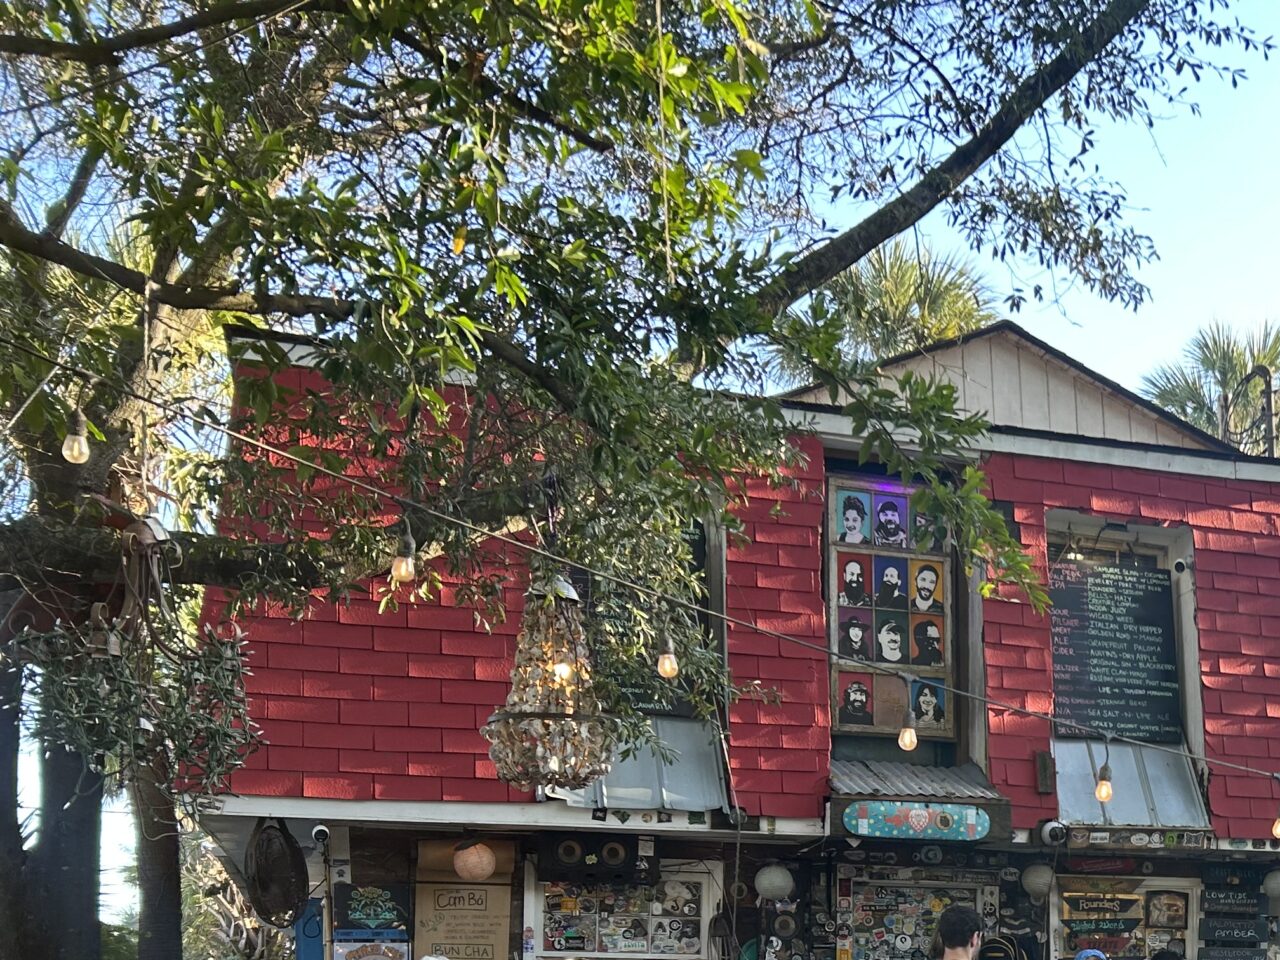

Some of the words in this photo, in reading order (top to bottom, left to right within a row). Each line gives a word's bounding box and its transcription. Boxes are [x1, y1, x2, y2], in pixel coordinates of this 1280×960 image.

[1049, 581, 1066, 590] IPA
[1050, 608, 1069, 616] SOUR
[1089, 620, 1119, 630] ITALIAN
[1123, 623, 1138, 632] DRY
[1054, 636, 1069, 645] ALE
[1133, 643, 1161, 652] PALOMA
[1053, 647, 1075, 656] CIDER
[1136, 653, 1157, 662] APPLE
[1056, 706, 1072, 715] N/A
[1087, 708, 1100, 717] SEA
[1102, 710, 1120, 718] SALT
[1205, 891, 1225, 899] LOW
[1215, 929, 1259, 939] AMBER
[434, 945, 460, 956] BUN
[464, 945, 489, 957] CHA
